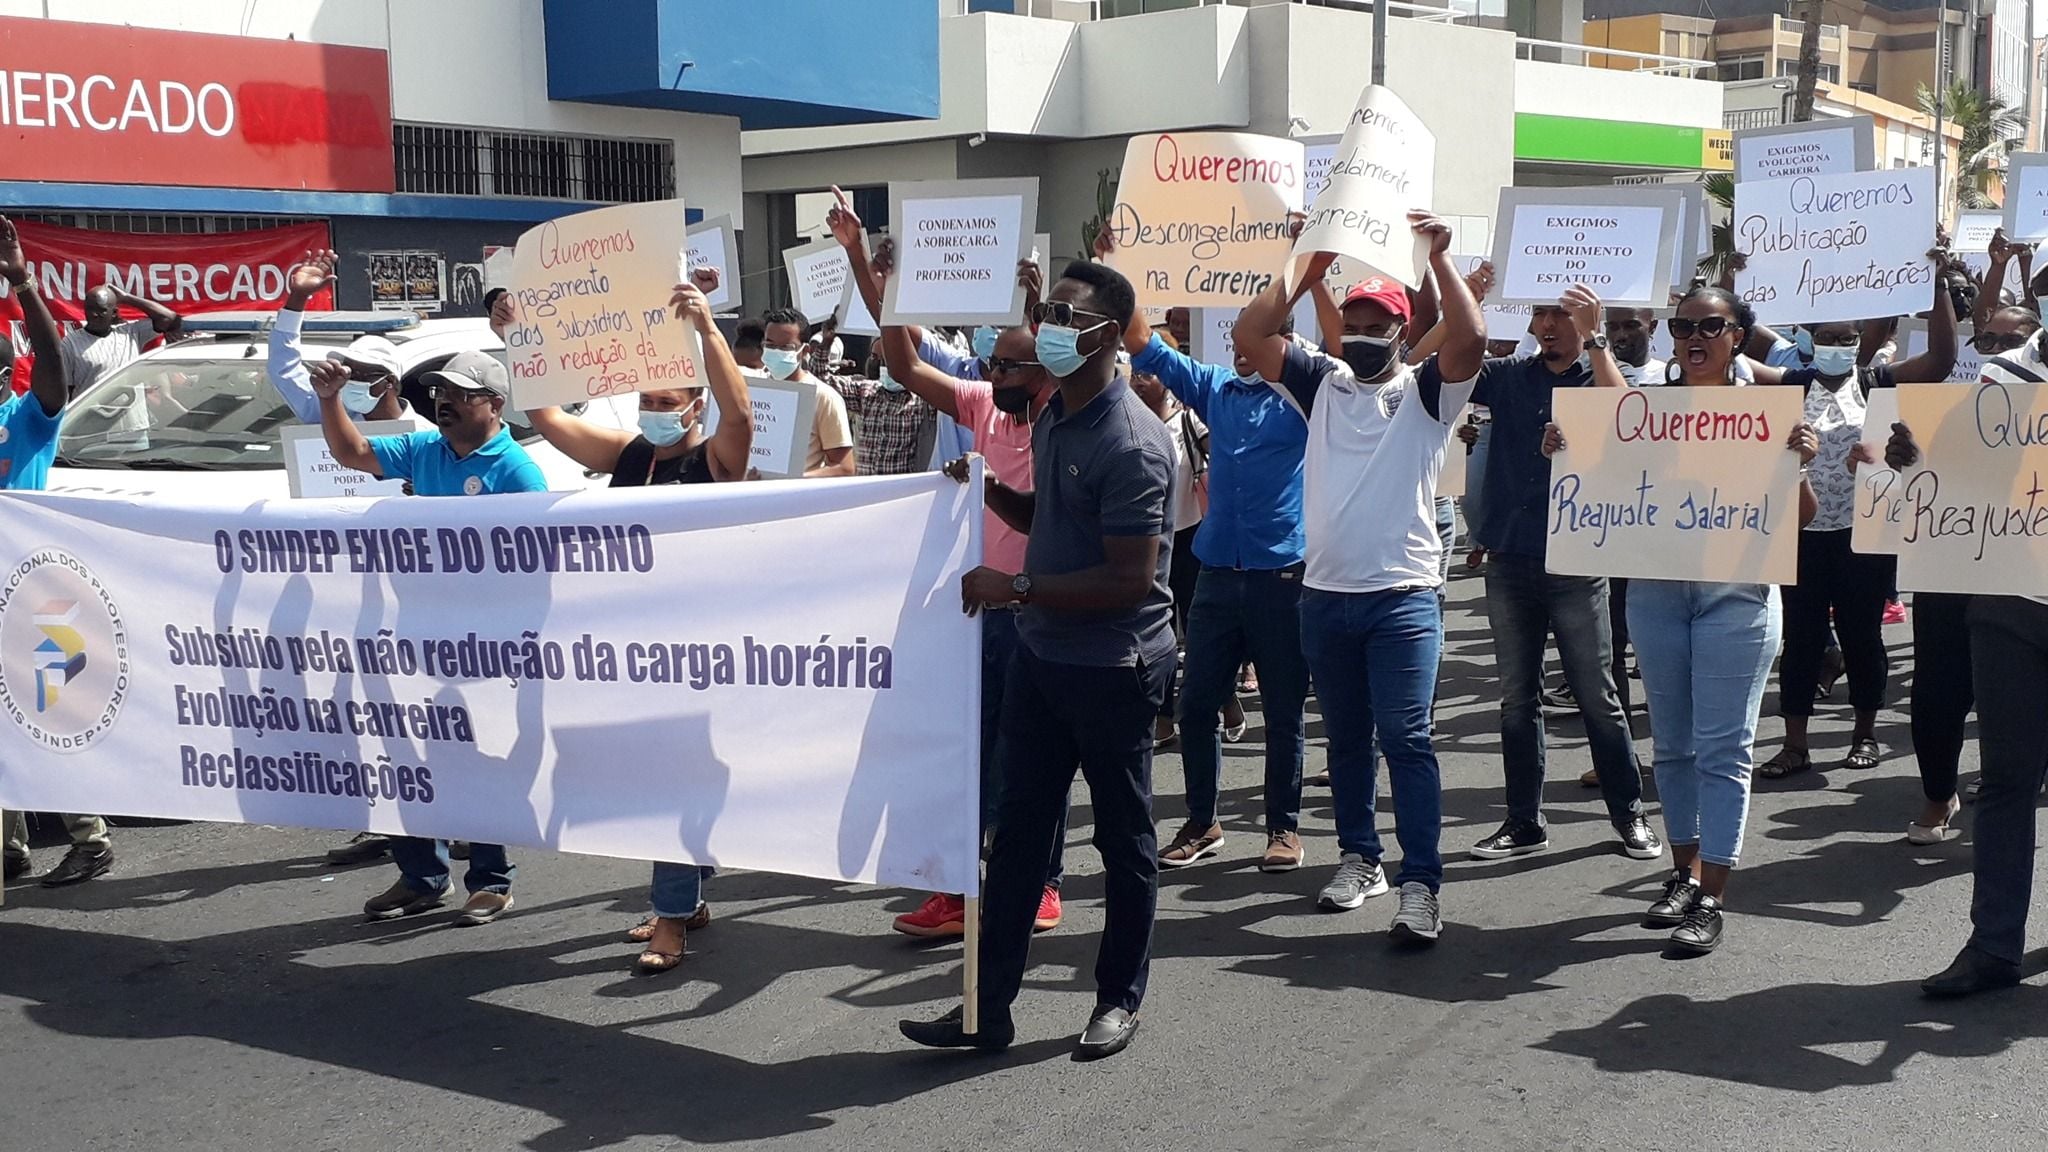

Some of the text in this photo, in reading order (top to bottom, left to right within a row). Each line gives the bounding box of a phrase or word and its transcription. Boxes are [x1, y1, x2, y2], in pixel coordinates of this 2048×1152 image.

[1154, 135, 1295, 187] Queremos
[1757, 154, 1830, 168] EVOLUÇÃO NA
[1767, 144, 1821, 156] EXIGIMOS
[1768, 166, 1820, 177] CARREIRA
[1790, 176, 1913, 215] Queremos
[918, 217, 996, 231] CONDENAMOS
[1546, 217, 1618, 229] EXIGIMOS
[1574, 232, 1585, 242] O
[1741, 215, 1867, 257] Publicação
[541, 220, 635, 269] Queremos
[914, 235, 998, 248] A SOBRECARGA
[1524, 245, 1632, 257] CUMPRIMENTO
[943, 252, 965, 264] DOS
[1566, 260, 1586, 270] DO
[915, 269, 991, 281] PROFESSORES
[1147, 264, 1272, 296] na Carreira
[1536, 272, 1612, 285] ESTATUTO
[1743, 258, 1931, 308] das Aposentações
[518, 262, 609, 321] pagamento
[510, 304, 668, 348] dos subsídios por
[513, 332, 657, 378] não redução da
[645, 354, 696, 381] horária
[1616, 391, 1770, 442] Queremos
[334, 475, 366, 484] PODER
[344, 487, 357, 496] DE
[1551, 470, 1659, 548] Reajuste
[1904, 470, 2048, 560] Reajuste
[214, 524, 654, 573] O SINDEP EXIGE DO GOVERNO
[59, 553, 88, 578] DOS
[91, 577, 128, 727] PROFESSORES
[165, 624, 893, 691] Subsídio pela não redução da carga horária
[175, 684, 474, 743] Evolução na carreira
[31, 727, 94, 749] SINDEP
[180, 745, 435, 807] Reclassificações
